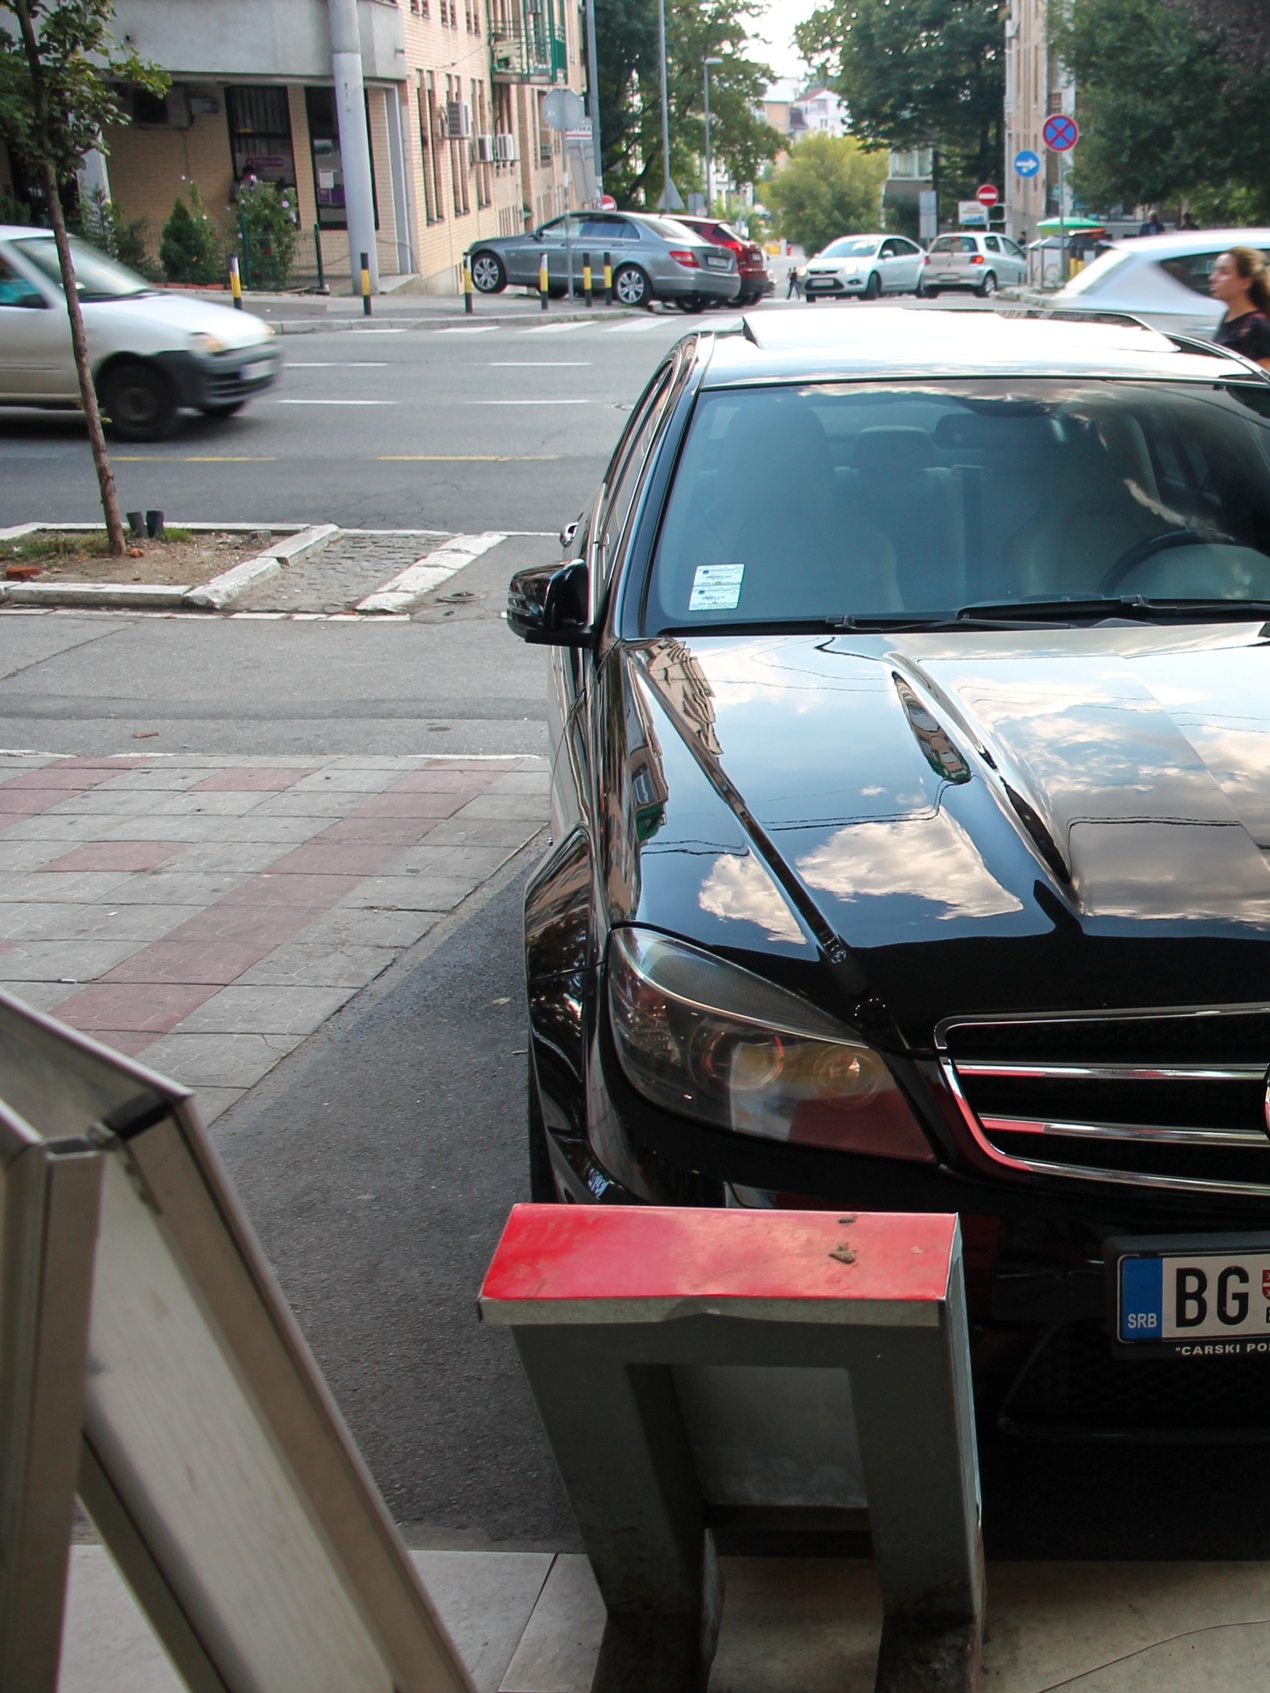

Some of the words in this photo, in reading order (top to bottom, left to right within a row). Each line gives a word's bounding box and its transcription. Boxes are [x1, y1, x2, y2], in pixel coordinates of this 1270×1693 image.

[1176, 1265, 1249, 1328] BG
[1128, 1313, 1157, 1329] SRB
[1175, 1344, 1240, 1356] "CARSKI
